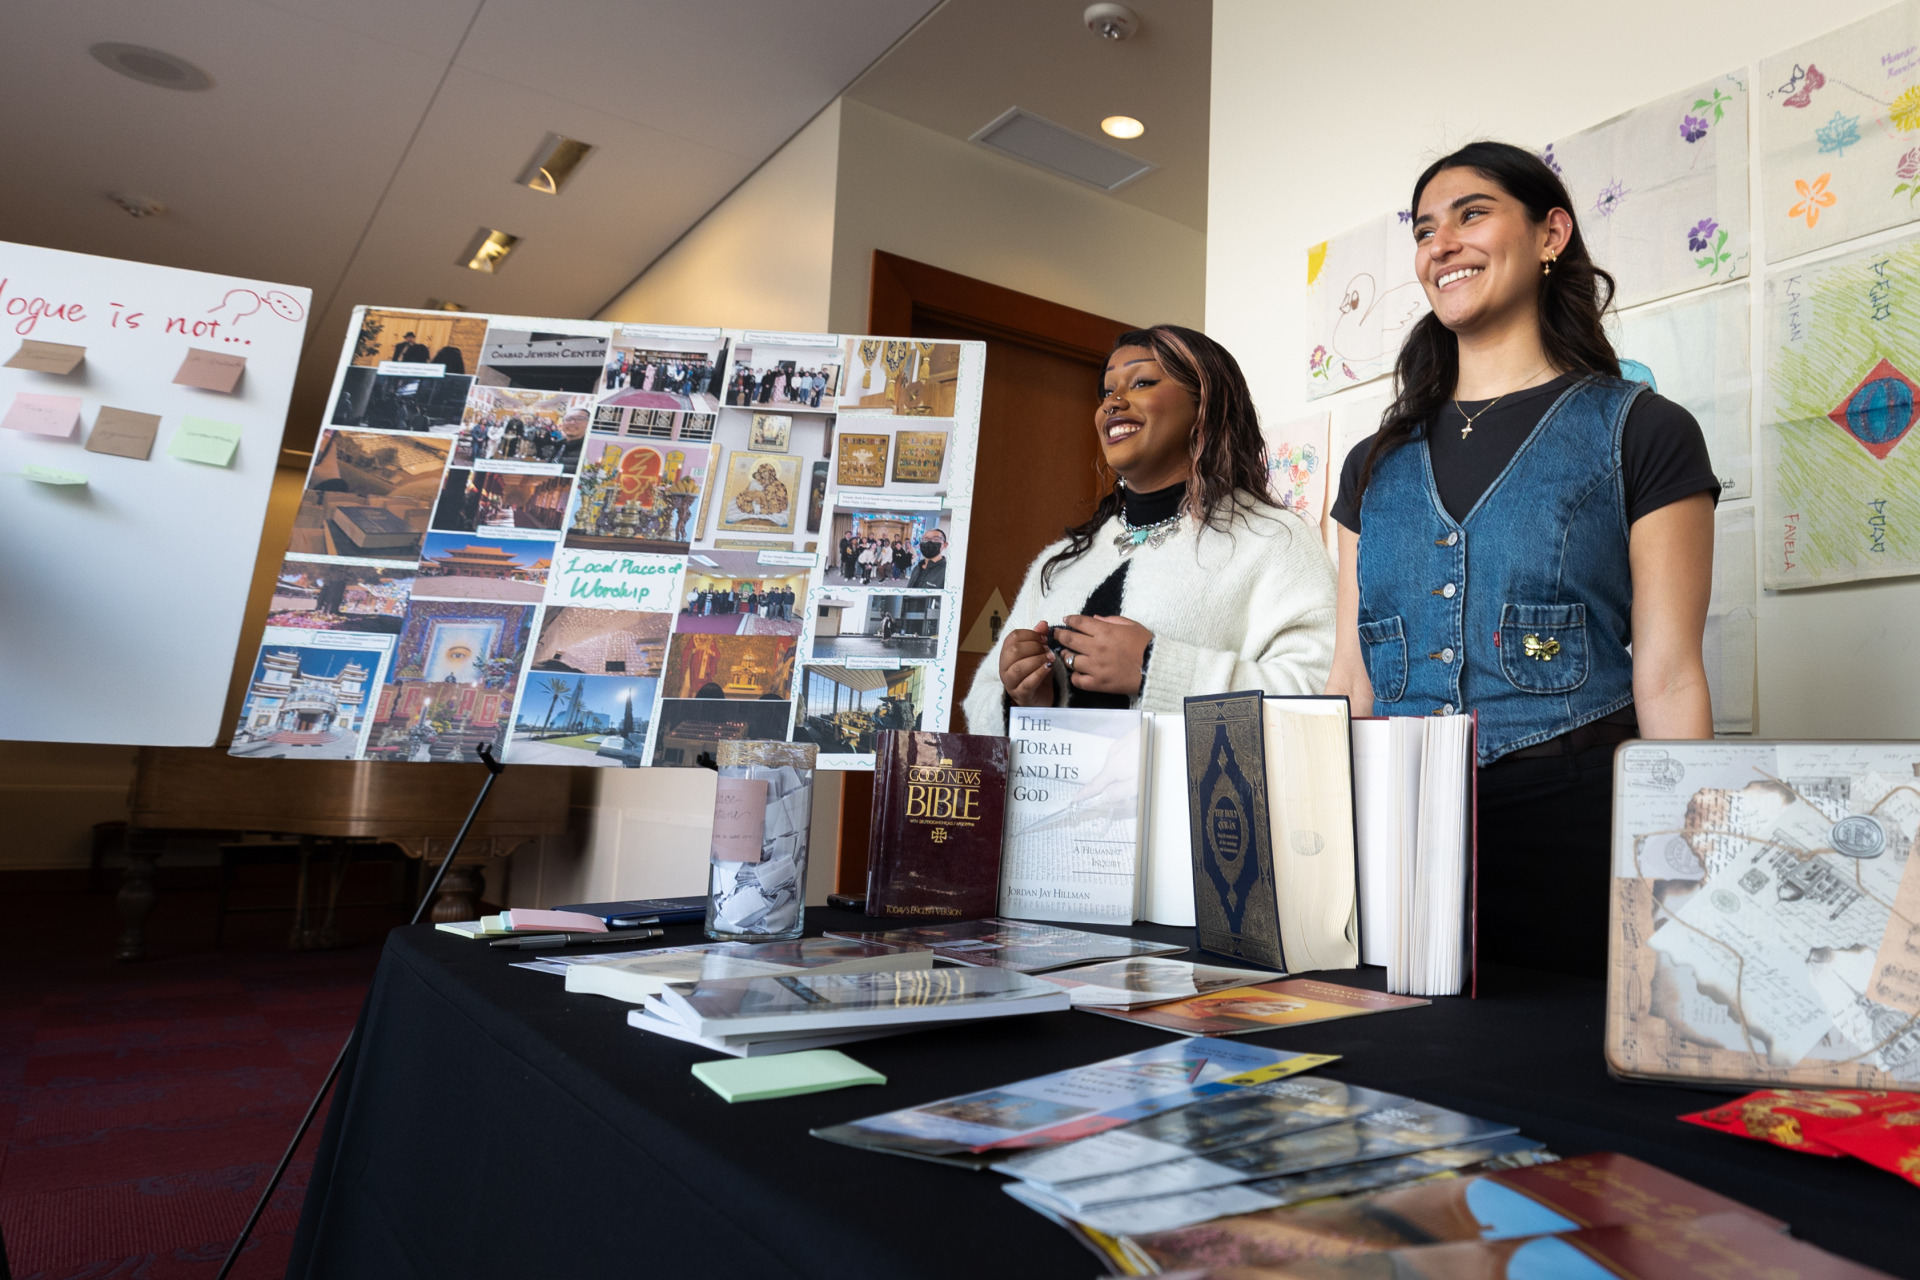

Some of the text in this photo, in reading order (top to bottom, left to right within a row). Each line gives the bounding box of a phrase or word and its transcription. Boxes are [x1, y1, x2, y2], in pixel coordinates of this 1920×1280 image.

[110, 302, 144, 329] is
[525, 350, 559, 359] JEWISH
[561, 348, 606, 359] CENTER
[1783, 513, 1800, 573] FAVELA
[564, 556, 682, 575] Local Places of
[570, 576, 649, 603] Worship
[1017, 715, 1052, 732] THE
[1016, 739, 1072, 756] TORAH
[909, 768, 981, 785] GOOD NEWS
[1015, 763, 1079, 780] AND ITS
[1013, 785, 1049, 802] GOD
[906, 785, 981, 820] BIBLE
[1073, 846, 1122, 856] A HUMANIST
[1092, 858, 1121, 868] INQUIRY
[1007, 885, 1090, 900] JORDAN JAY HILLMAN
[935, 906, 962, 916] VERSION
